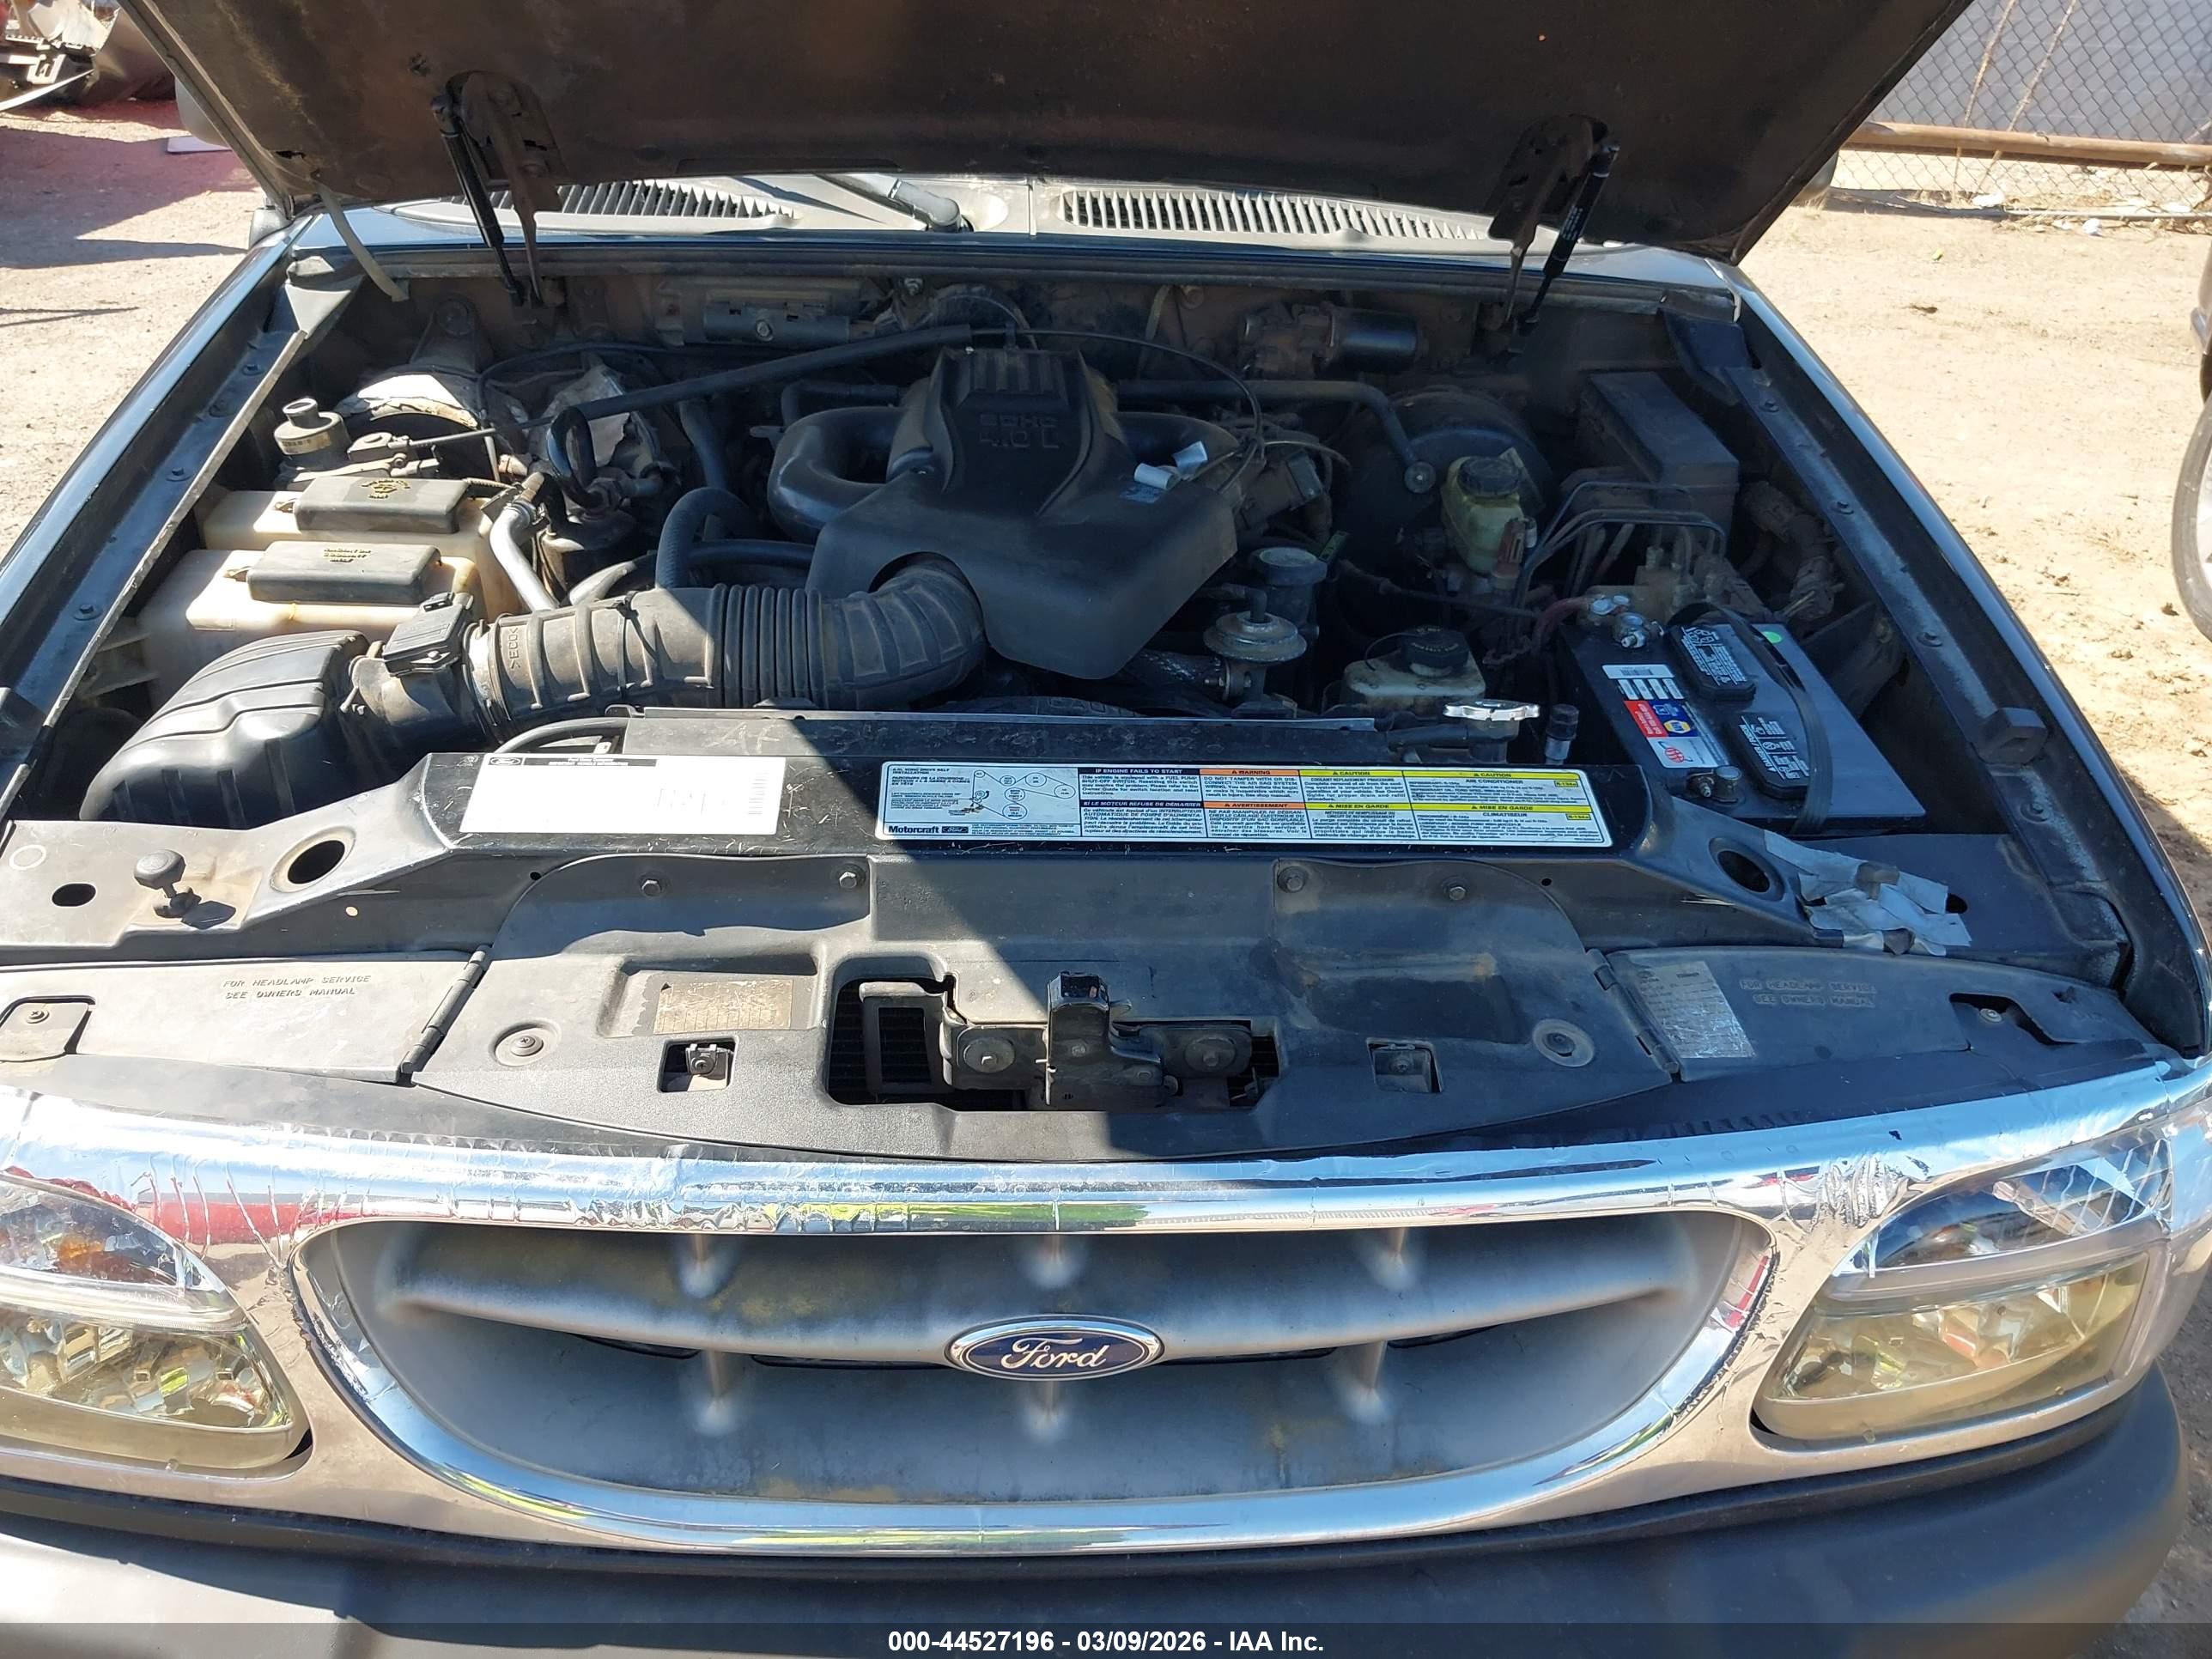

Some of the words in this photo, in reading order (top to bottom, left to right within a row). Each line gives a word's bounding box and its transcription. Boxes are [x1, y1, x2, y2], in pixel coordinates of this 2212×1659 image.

[888, 825, 938, 833] Motorcraft
[1740, 979, 1762, 990] FOR
[1753, 994, 1777, 1005] SEE
[1000, 1337, 1110, 1369] Ford
